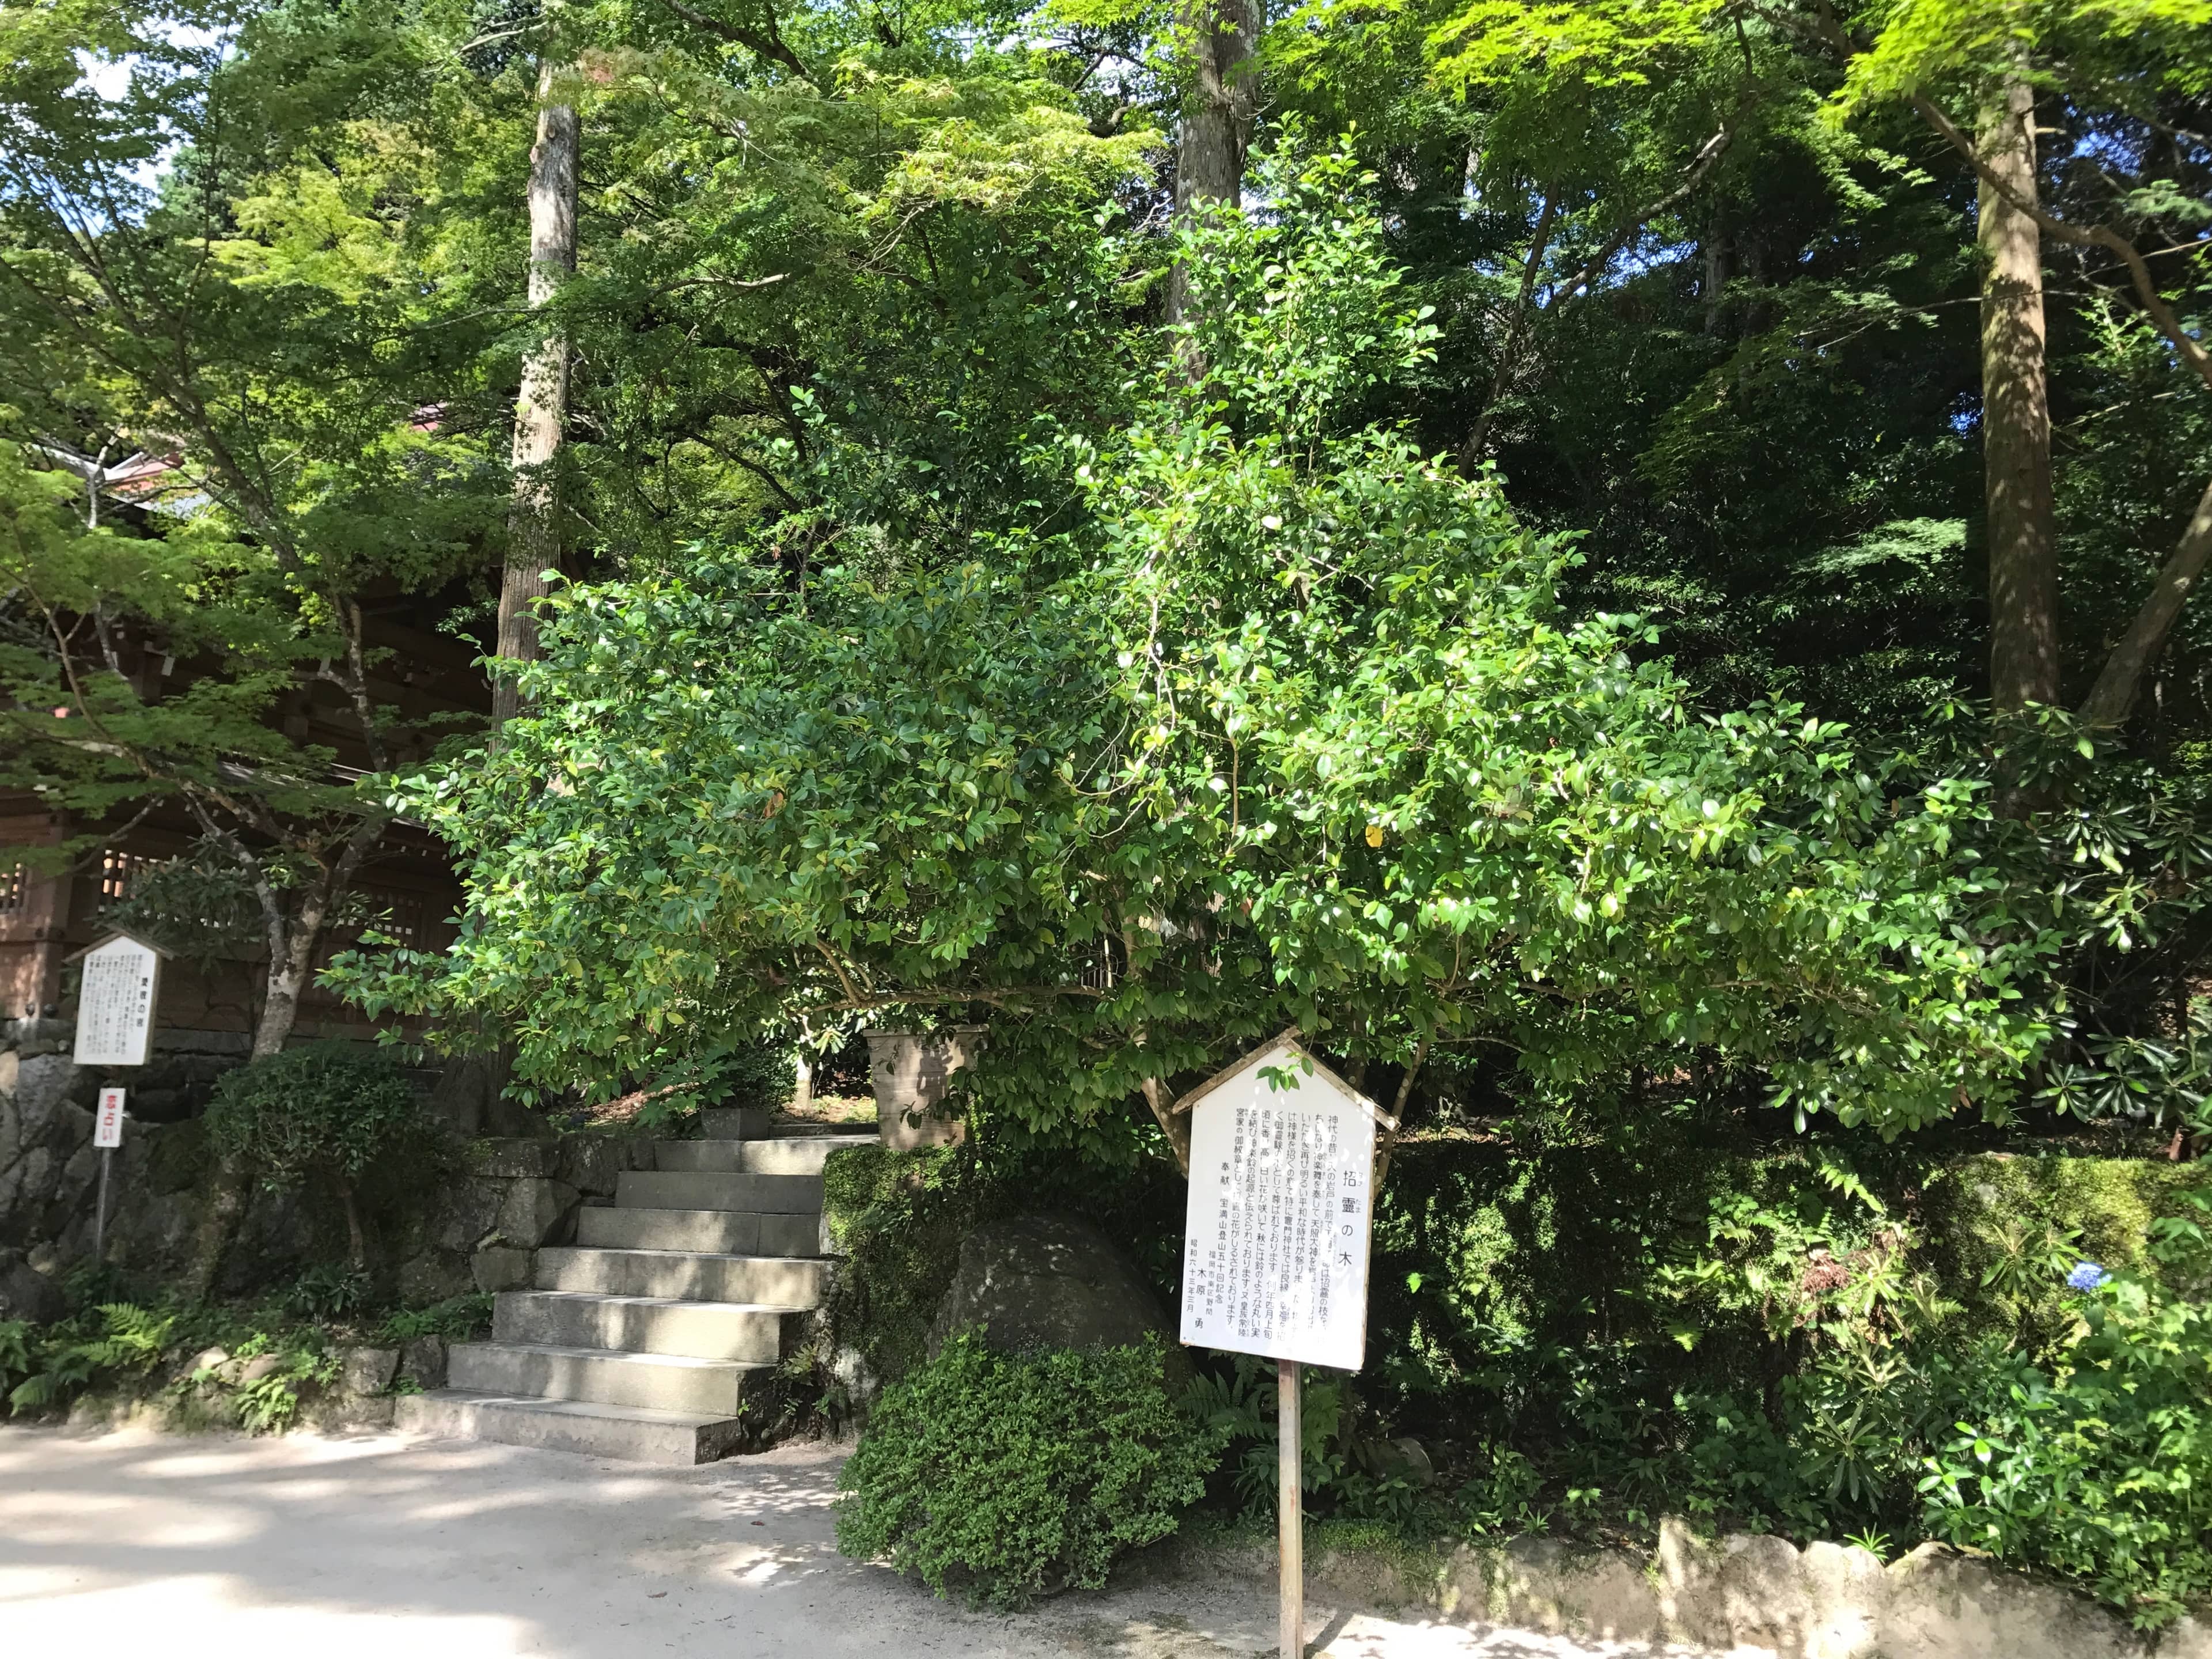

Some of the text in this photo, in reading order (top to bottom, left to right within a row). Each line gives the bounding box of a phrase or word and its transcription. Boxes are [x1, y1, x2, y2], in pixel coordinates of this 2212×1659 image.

[1187, 1239, 1198, 1313] 昭和六十三年三月
